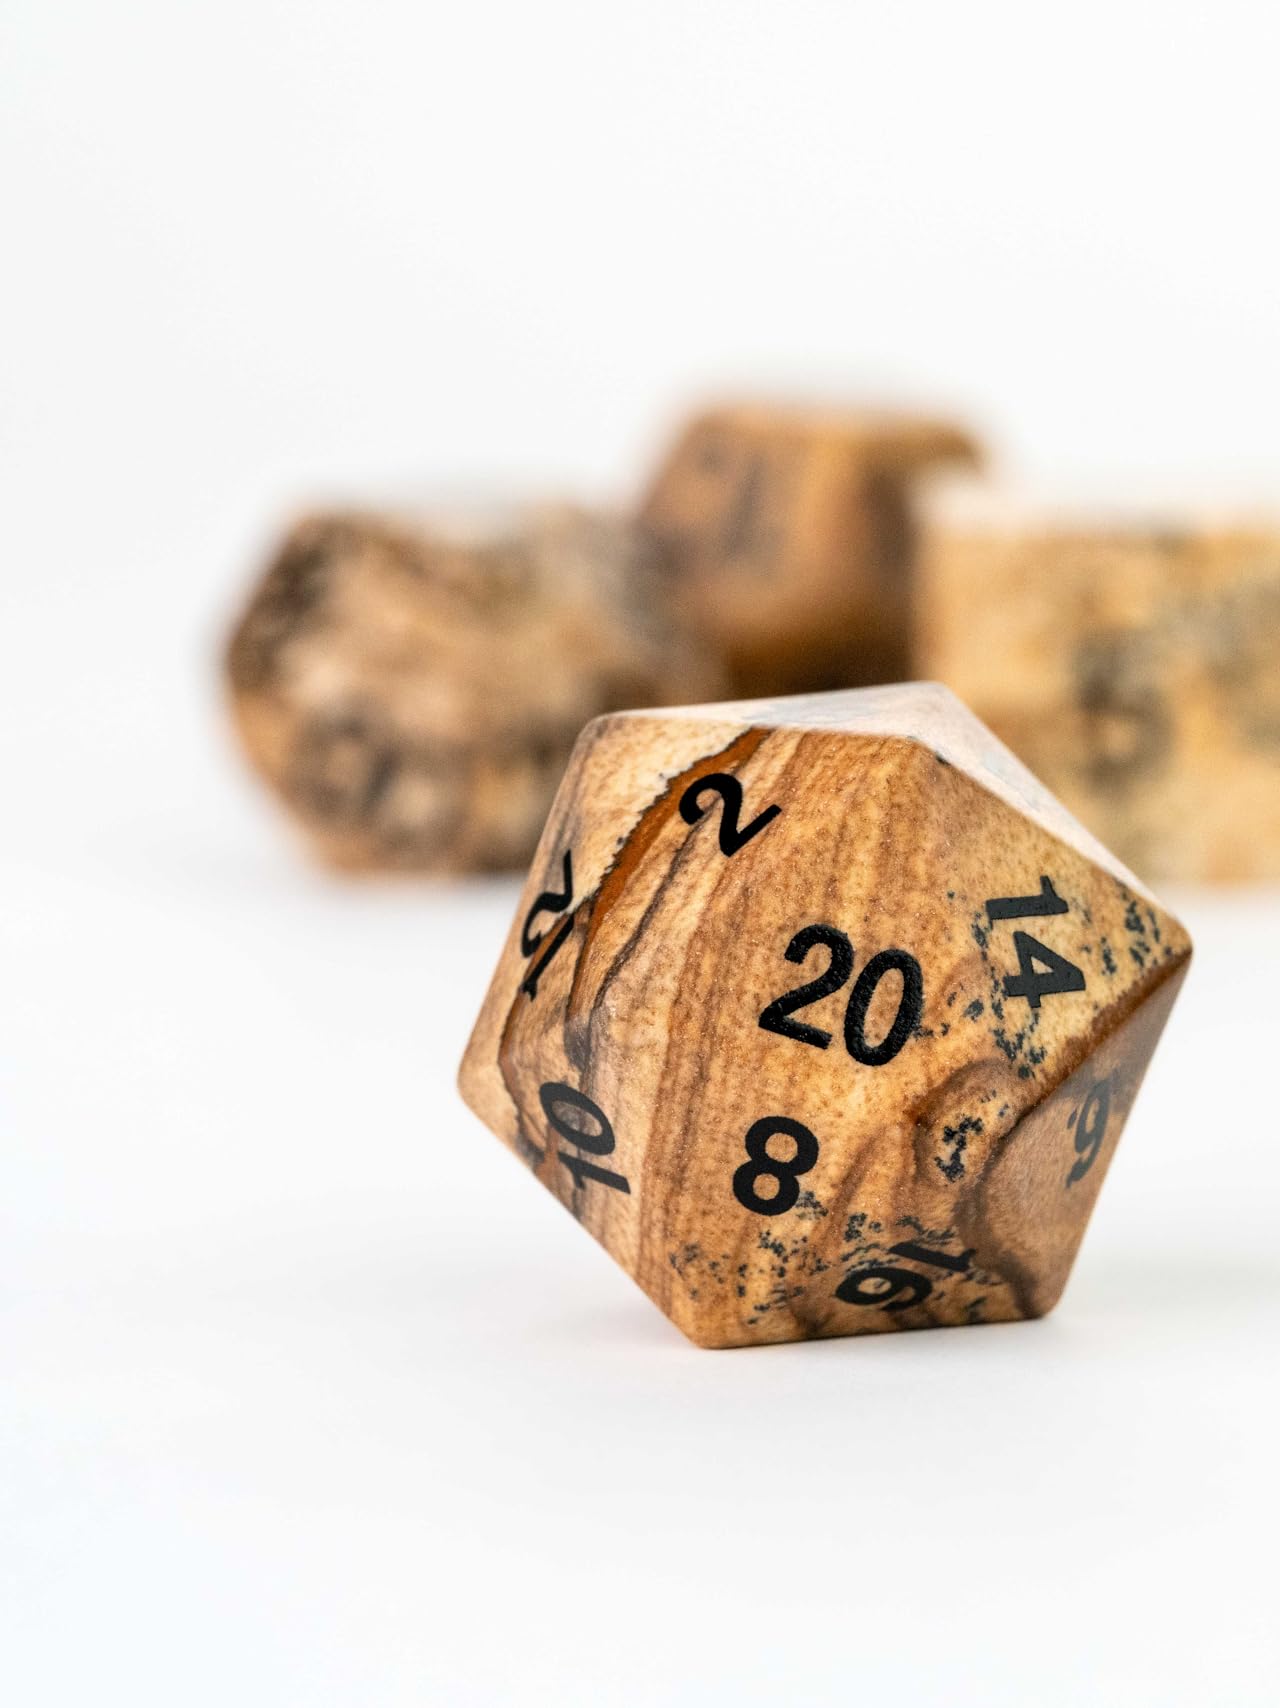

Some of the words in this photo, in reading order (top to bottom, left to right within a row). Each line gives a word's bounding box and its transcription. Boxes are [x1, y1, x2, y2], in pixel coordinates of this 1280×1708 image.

[679, 772, 782, 857] 2
[521, 849, 574, 1002] 12
[985, 875, 1086, 1008] 14
[758, 924, 924, 1066] 20
[539, 1081, 631, 1195] 10
[733, 1115, 819, 1216] 8
[835, 1240, 976, 1311] 16
